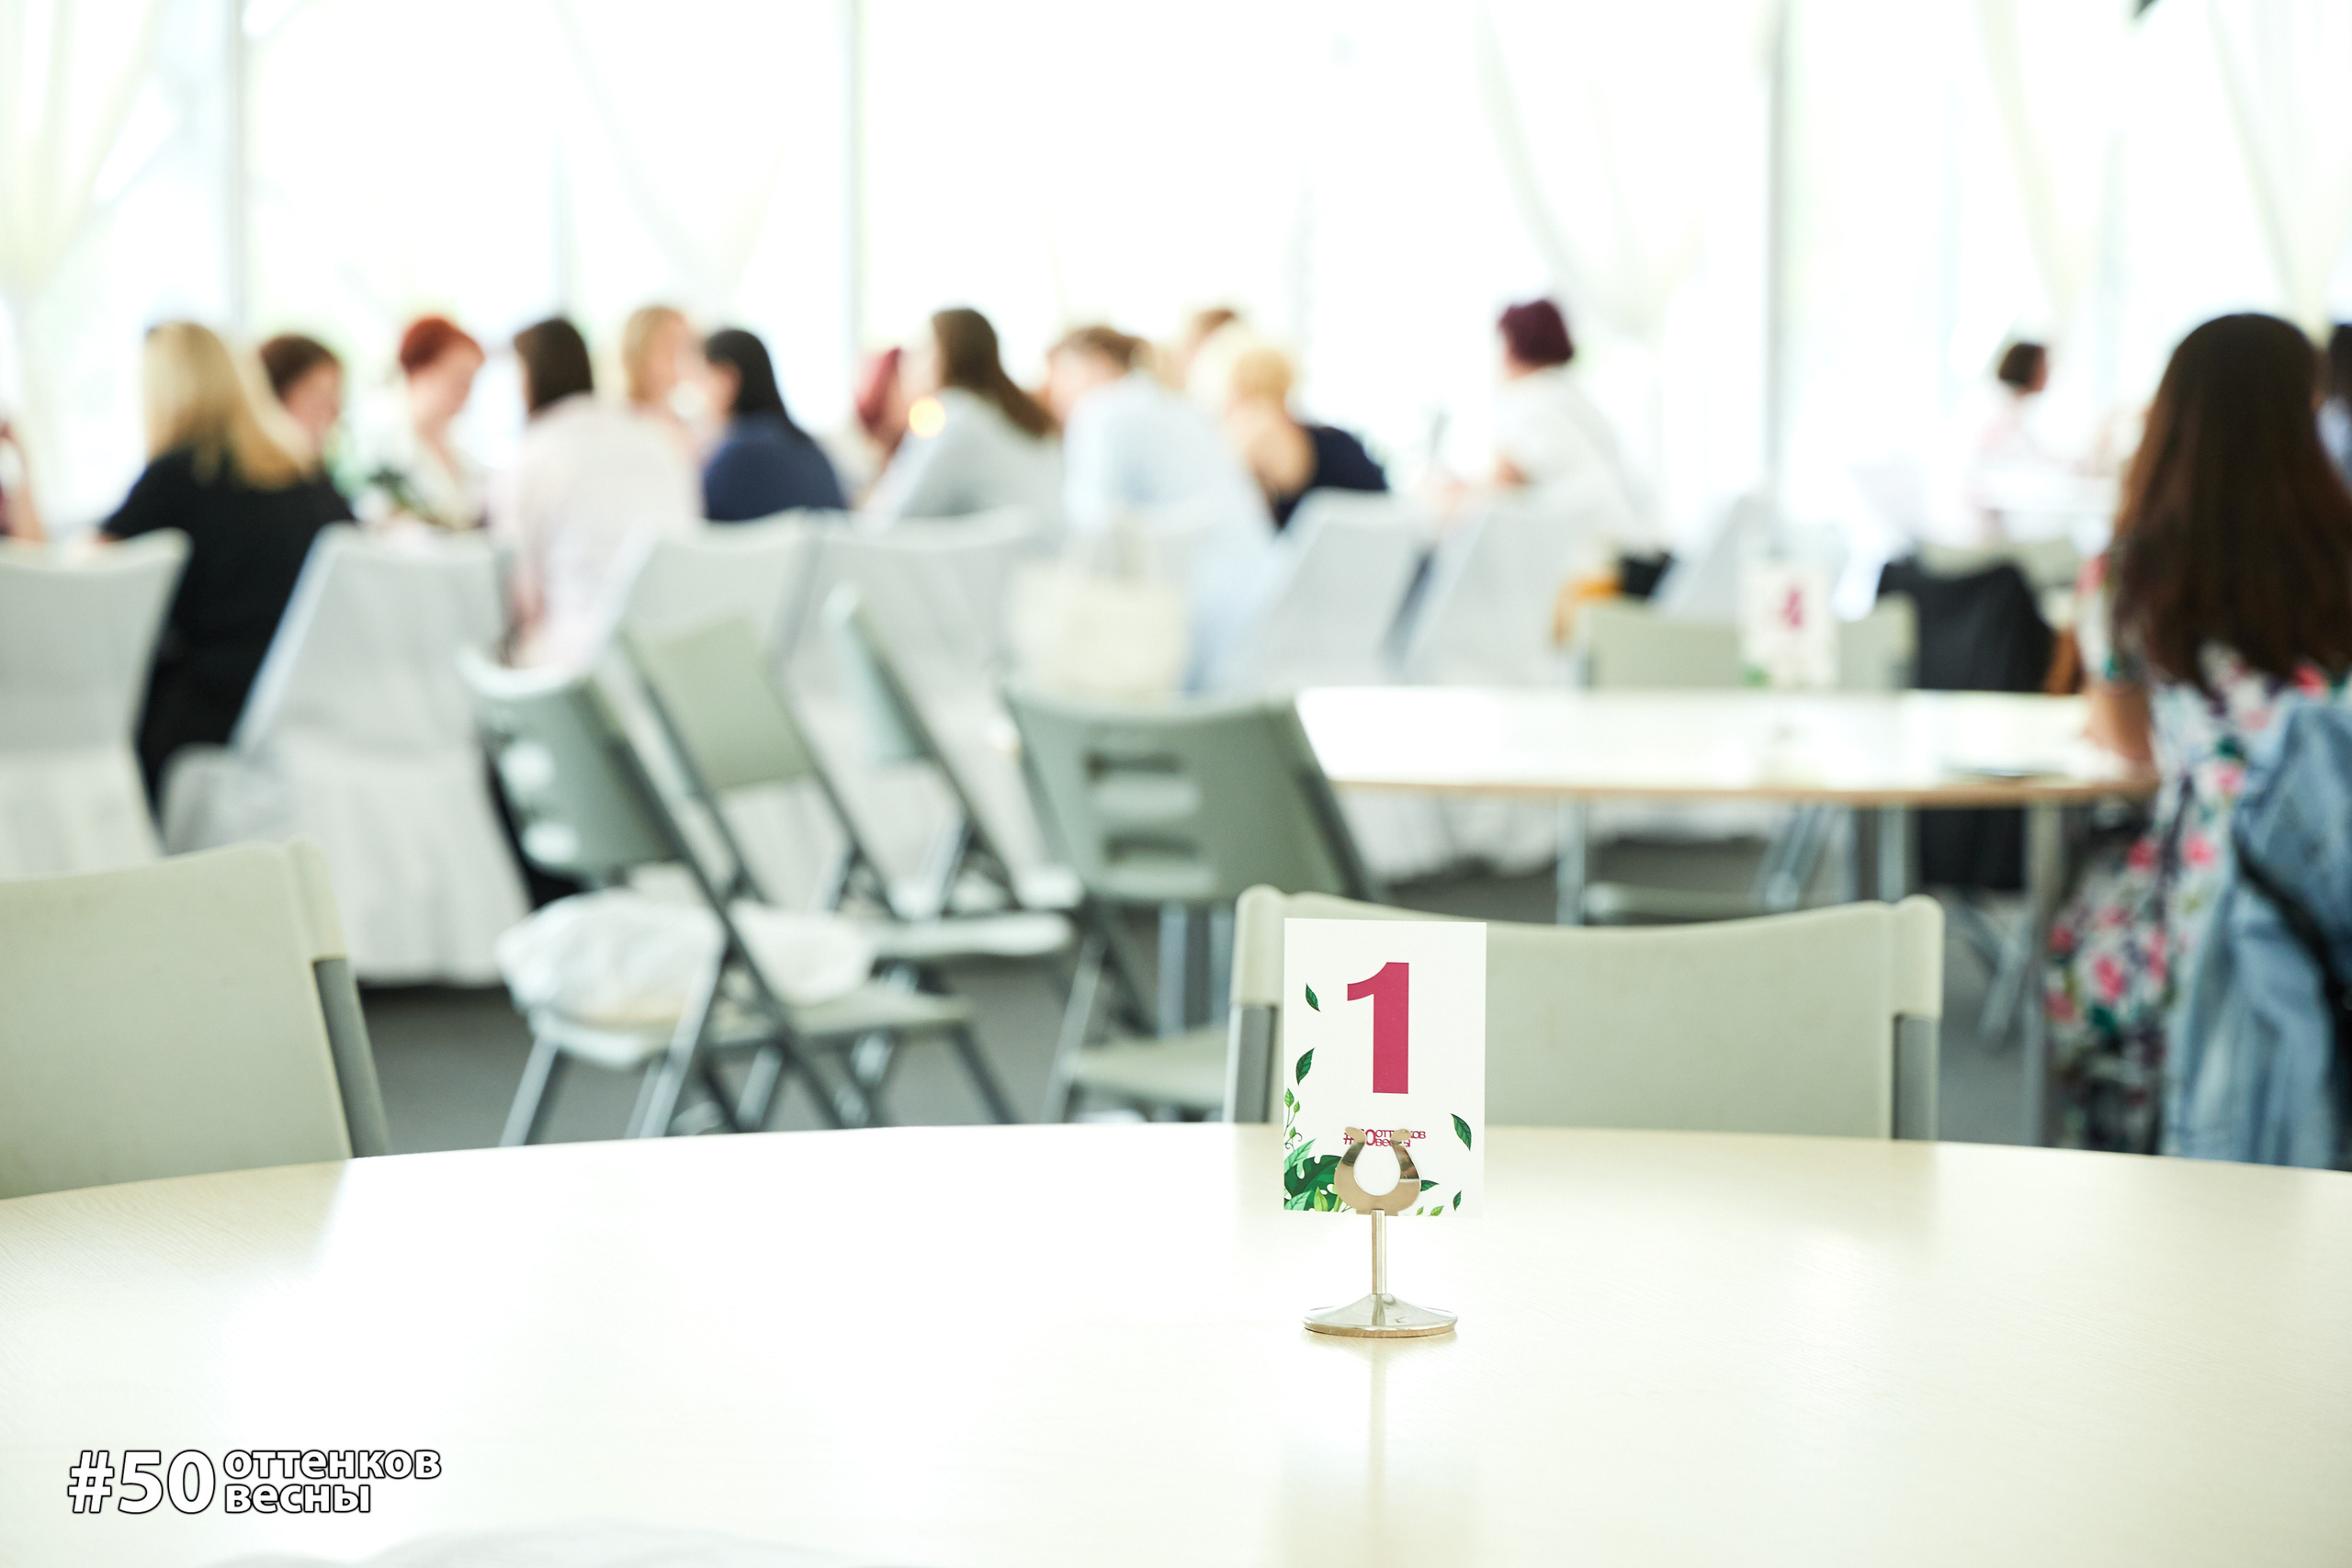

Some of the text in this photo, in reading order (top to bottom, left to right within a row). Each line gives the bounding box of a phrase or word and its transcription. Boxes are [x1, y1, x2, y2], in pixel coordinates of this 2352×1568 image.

[1347, 962, 1409, 1095] 1
[1342, 1128, 1427, 1146] #0 оттов
